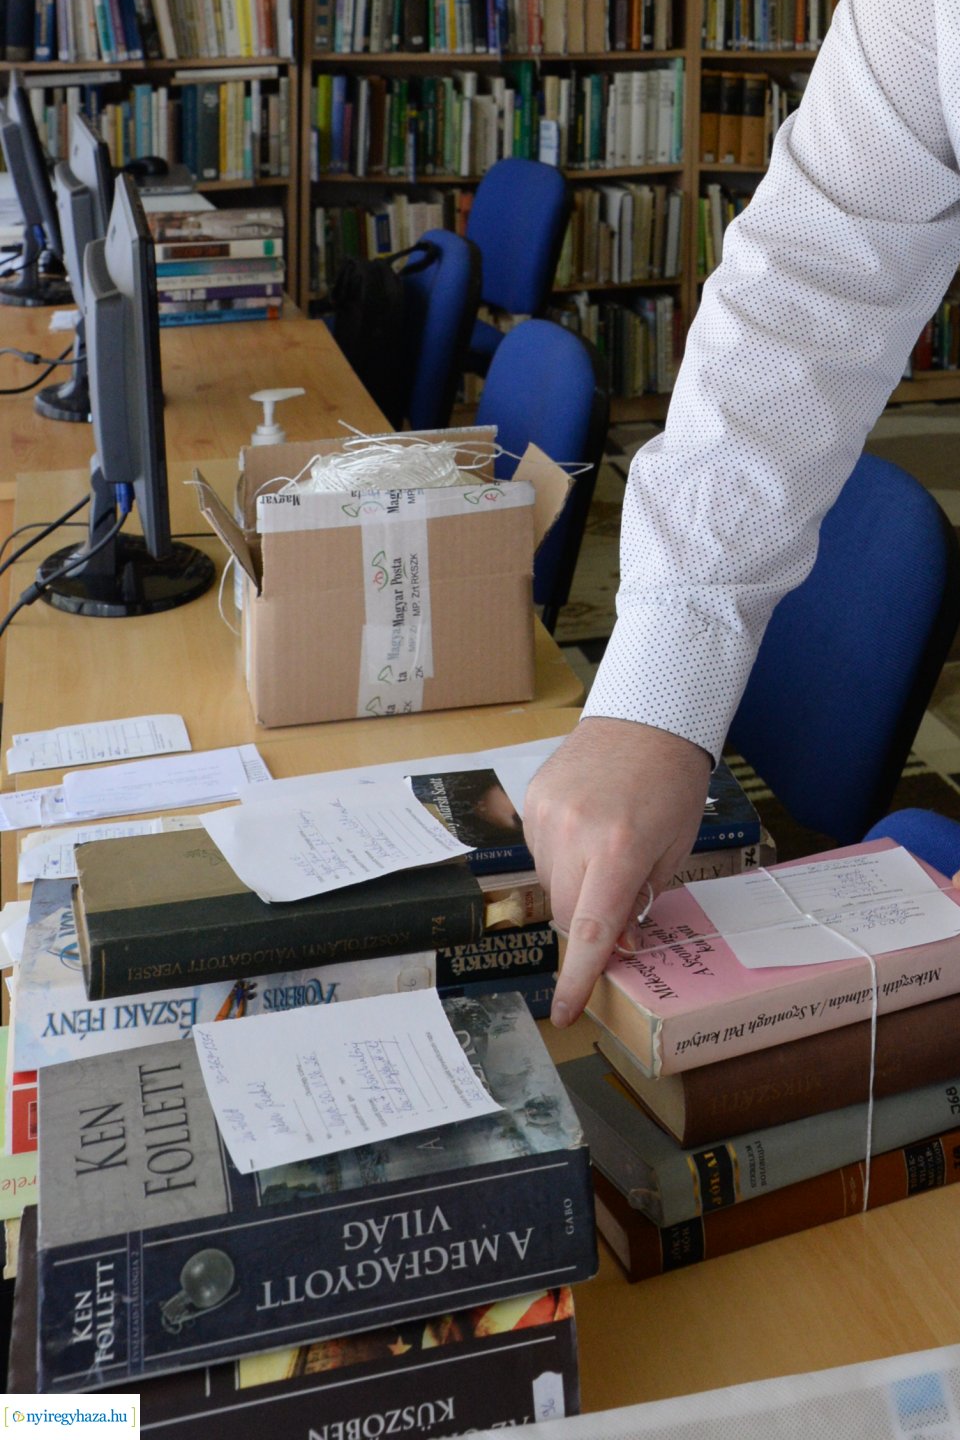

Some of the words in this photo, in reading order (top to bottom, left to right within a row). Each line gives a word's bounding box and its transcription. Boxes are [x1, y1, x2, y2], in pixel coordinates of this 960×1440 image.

[390, 557, 403, 586] Posta
[430, 777, 446, 795] Scott
[127, 962, 184, 981] VERSEI
[452, 946, 544, 977] ÖRÖKKÉ
[881, 965, 942, 997] Mikszáth
[41, 1006, 106, 1041] FÉNY
[114, 997, 199, 1040] ÉSZAKI
[722, 1023, 745, 1043] Pál
[749, 1004, 807, 1034] Szontagh
[674, 1029, 720, 1056] kutyái
[74, 1102, 128, 1178] KEN
[138, 1063, 197, 1198] FOLLETT
[1, 1175, 38, 1195] rele
[341, 1205, 452, 1254] VILÁG
[563, 1198, 574, 1235] GABO
[506, 1227, 535, 1260] A
[256, 1233, 500, 1311] MEGFAGYOTT
[72, 1289, 93, 1344] KEN
[96, 1260, 115, 1363] FOLLETT
